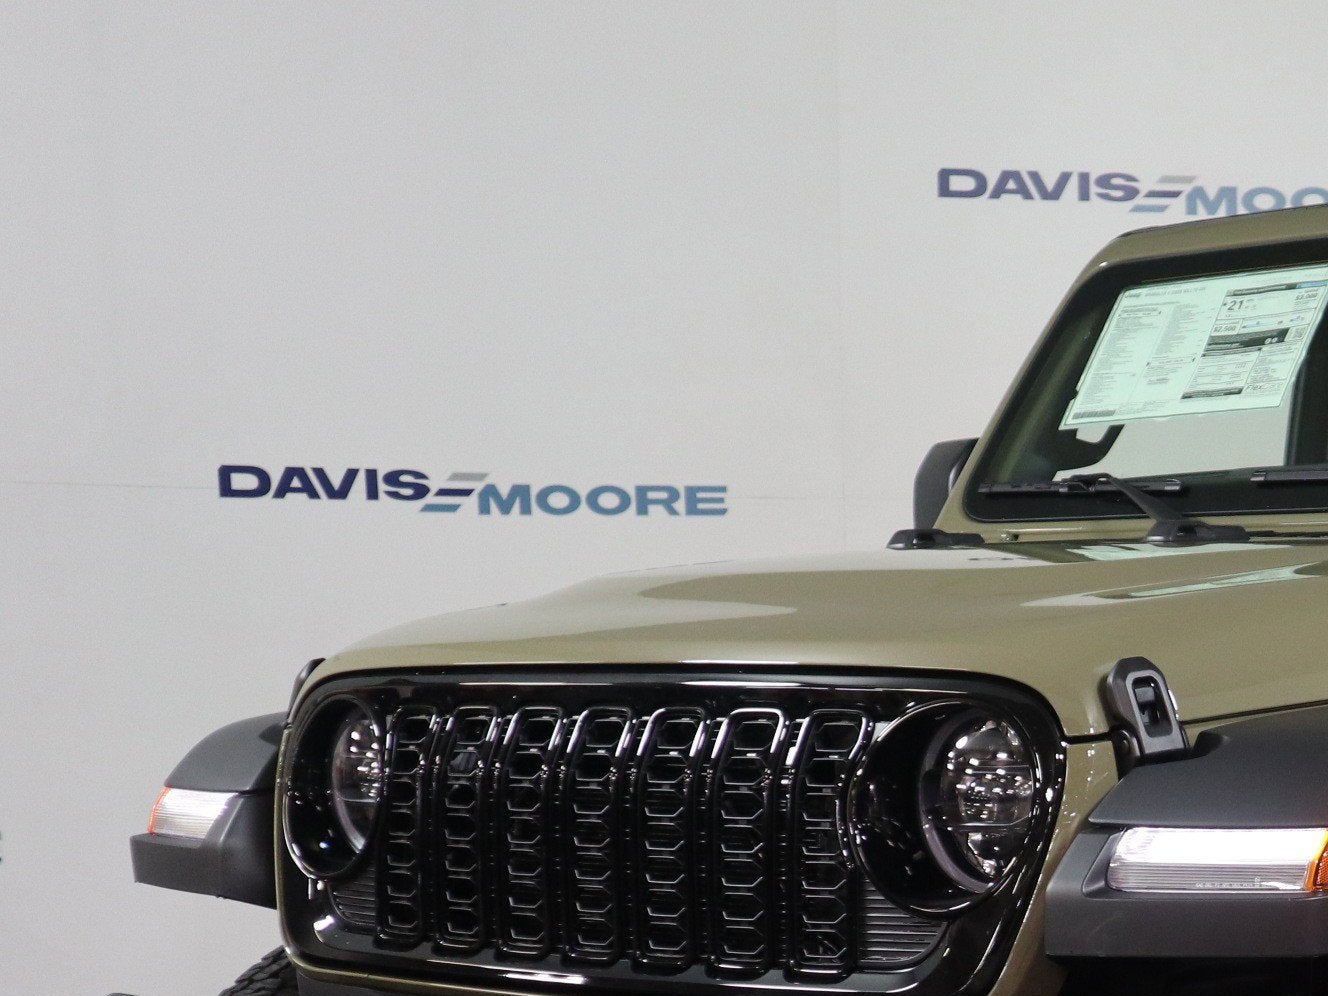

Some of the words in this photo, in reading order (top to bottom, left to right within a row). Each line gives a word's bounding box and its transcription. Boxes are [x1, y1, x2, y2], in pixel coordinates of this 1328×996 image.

[937, 167, 1139, 202] DAVIS
[1227, 299, 1244, 311] 21
[218, 464, 429, 503] DAVIS
[478, 484, 729, 517] MOORE
